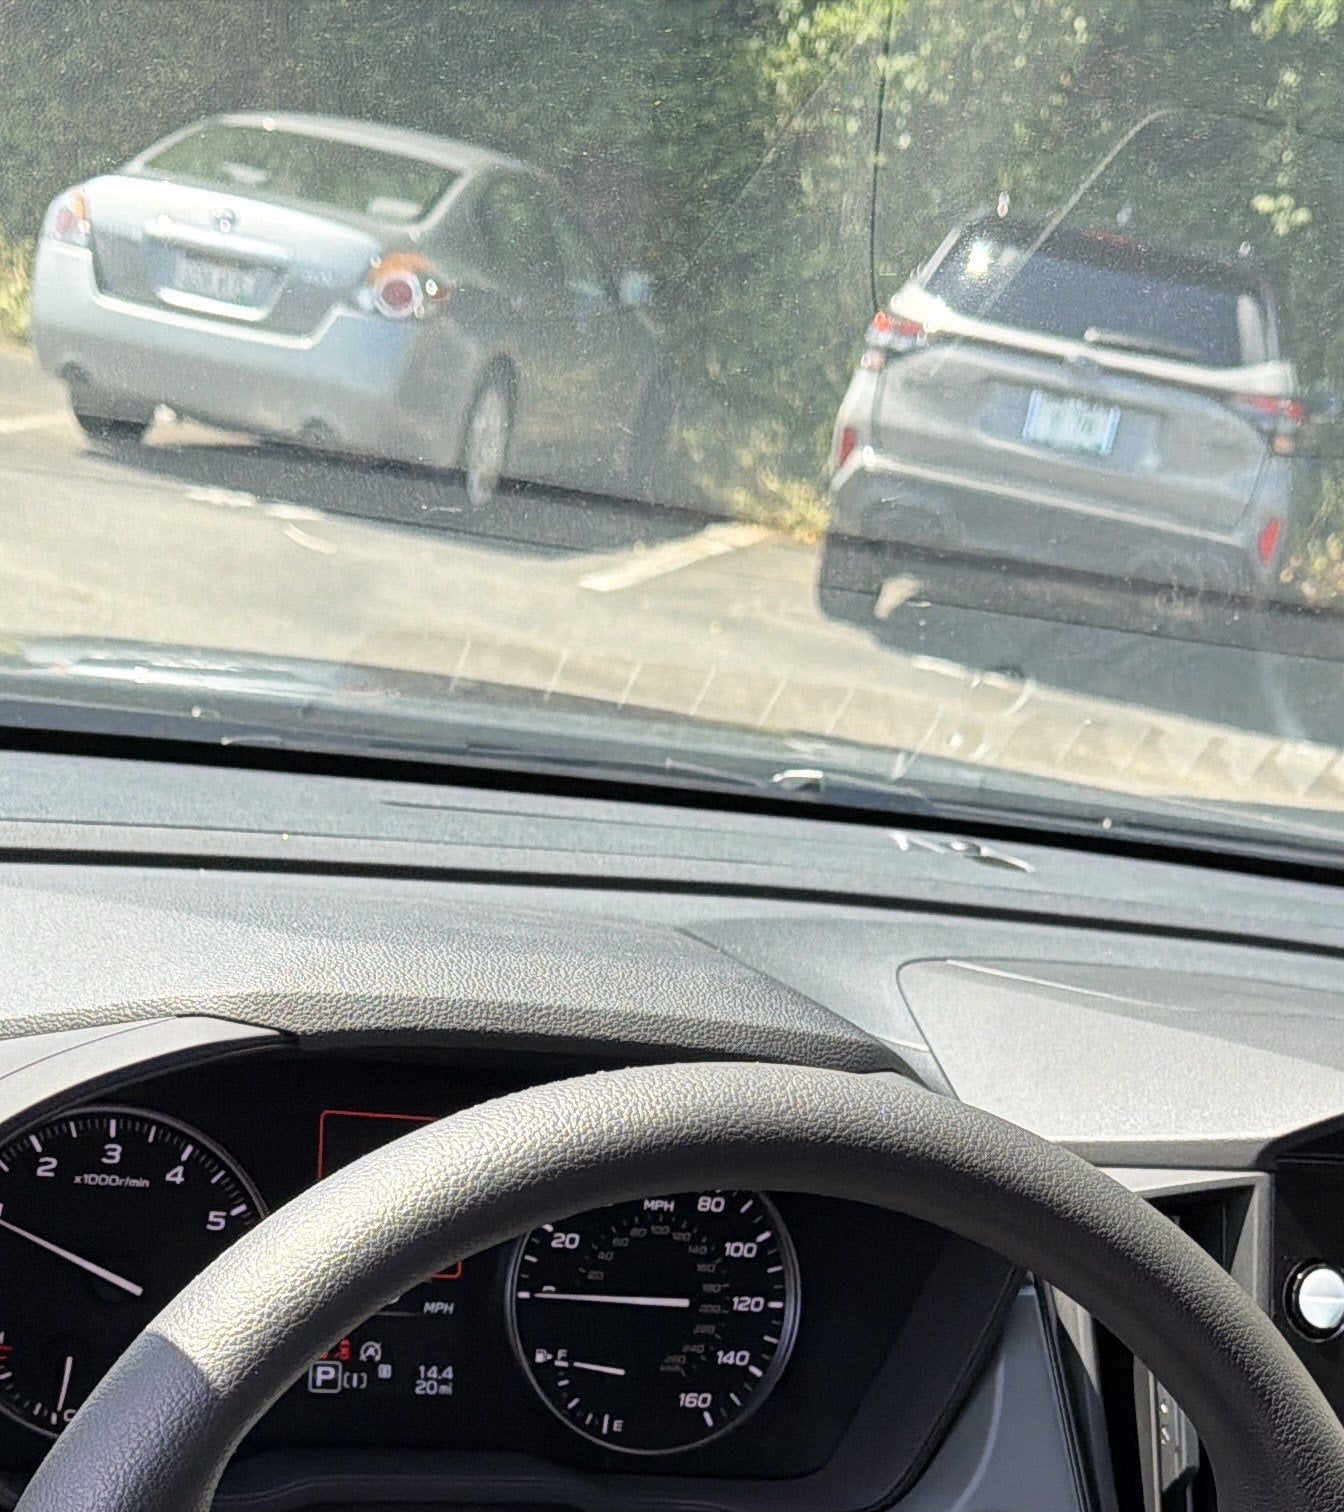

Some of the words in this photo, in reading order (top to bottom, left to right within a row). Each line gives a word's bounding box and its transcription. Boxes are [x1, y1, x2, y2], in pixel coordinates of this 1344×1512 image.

[101, 1144, 122, 1164] 3
[36, 1157, 58, 1177] 2
[165, 1166, 184, 1184] 4
[643, 1199, 675, 1212] MPH
[697, 1196, 725, 1213] 80
[206, 1211, 227, 1231] 5
[551, 1232, 580, 1249] 20
[724, 1241, 757, 1258] 100
[422, 1301, 455, 1315] MPH
[732, 1296, 765, 1312] 120
[716, 1350, 750, 1367] 140
[315, 1365, 336, 1387] P
[419, 1365, 454, 1380] 14.4
[679, 1392, 712, 1409] 160
[612, 1419, 624, 1433] E
